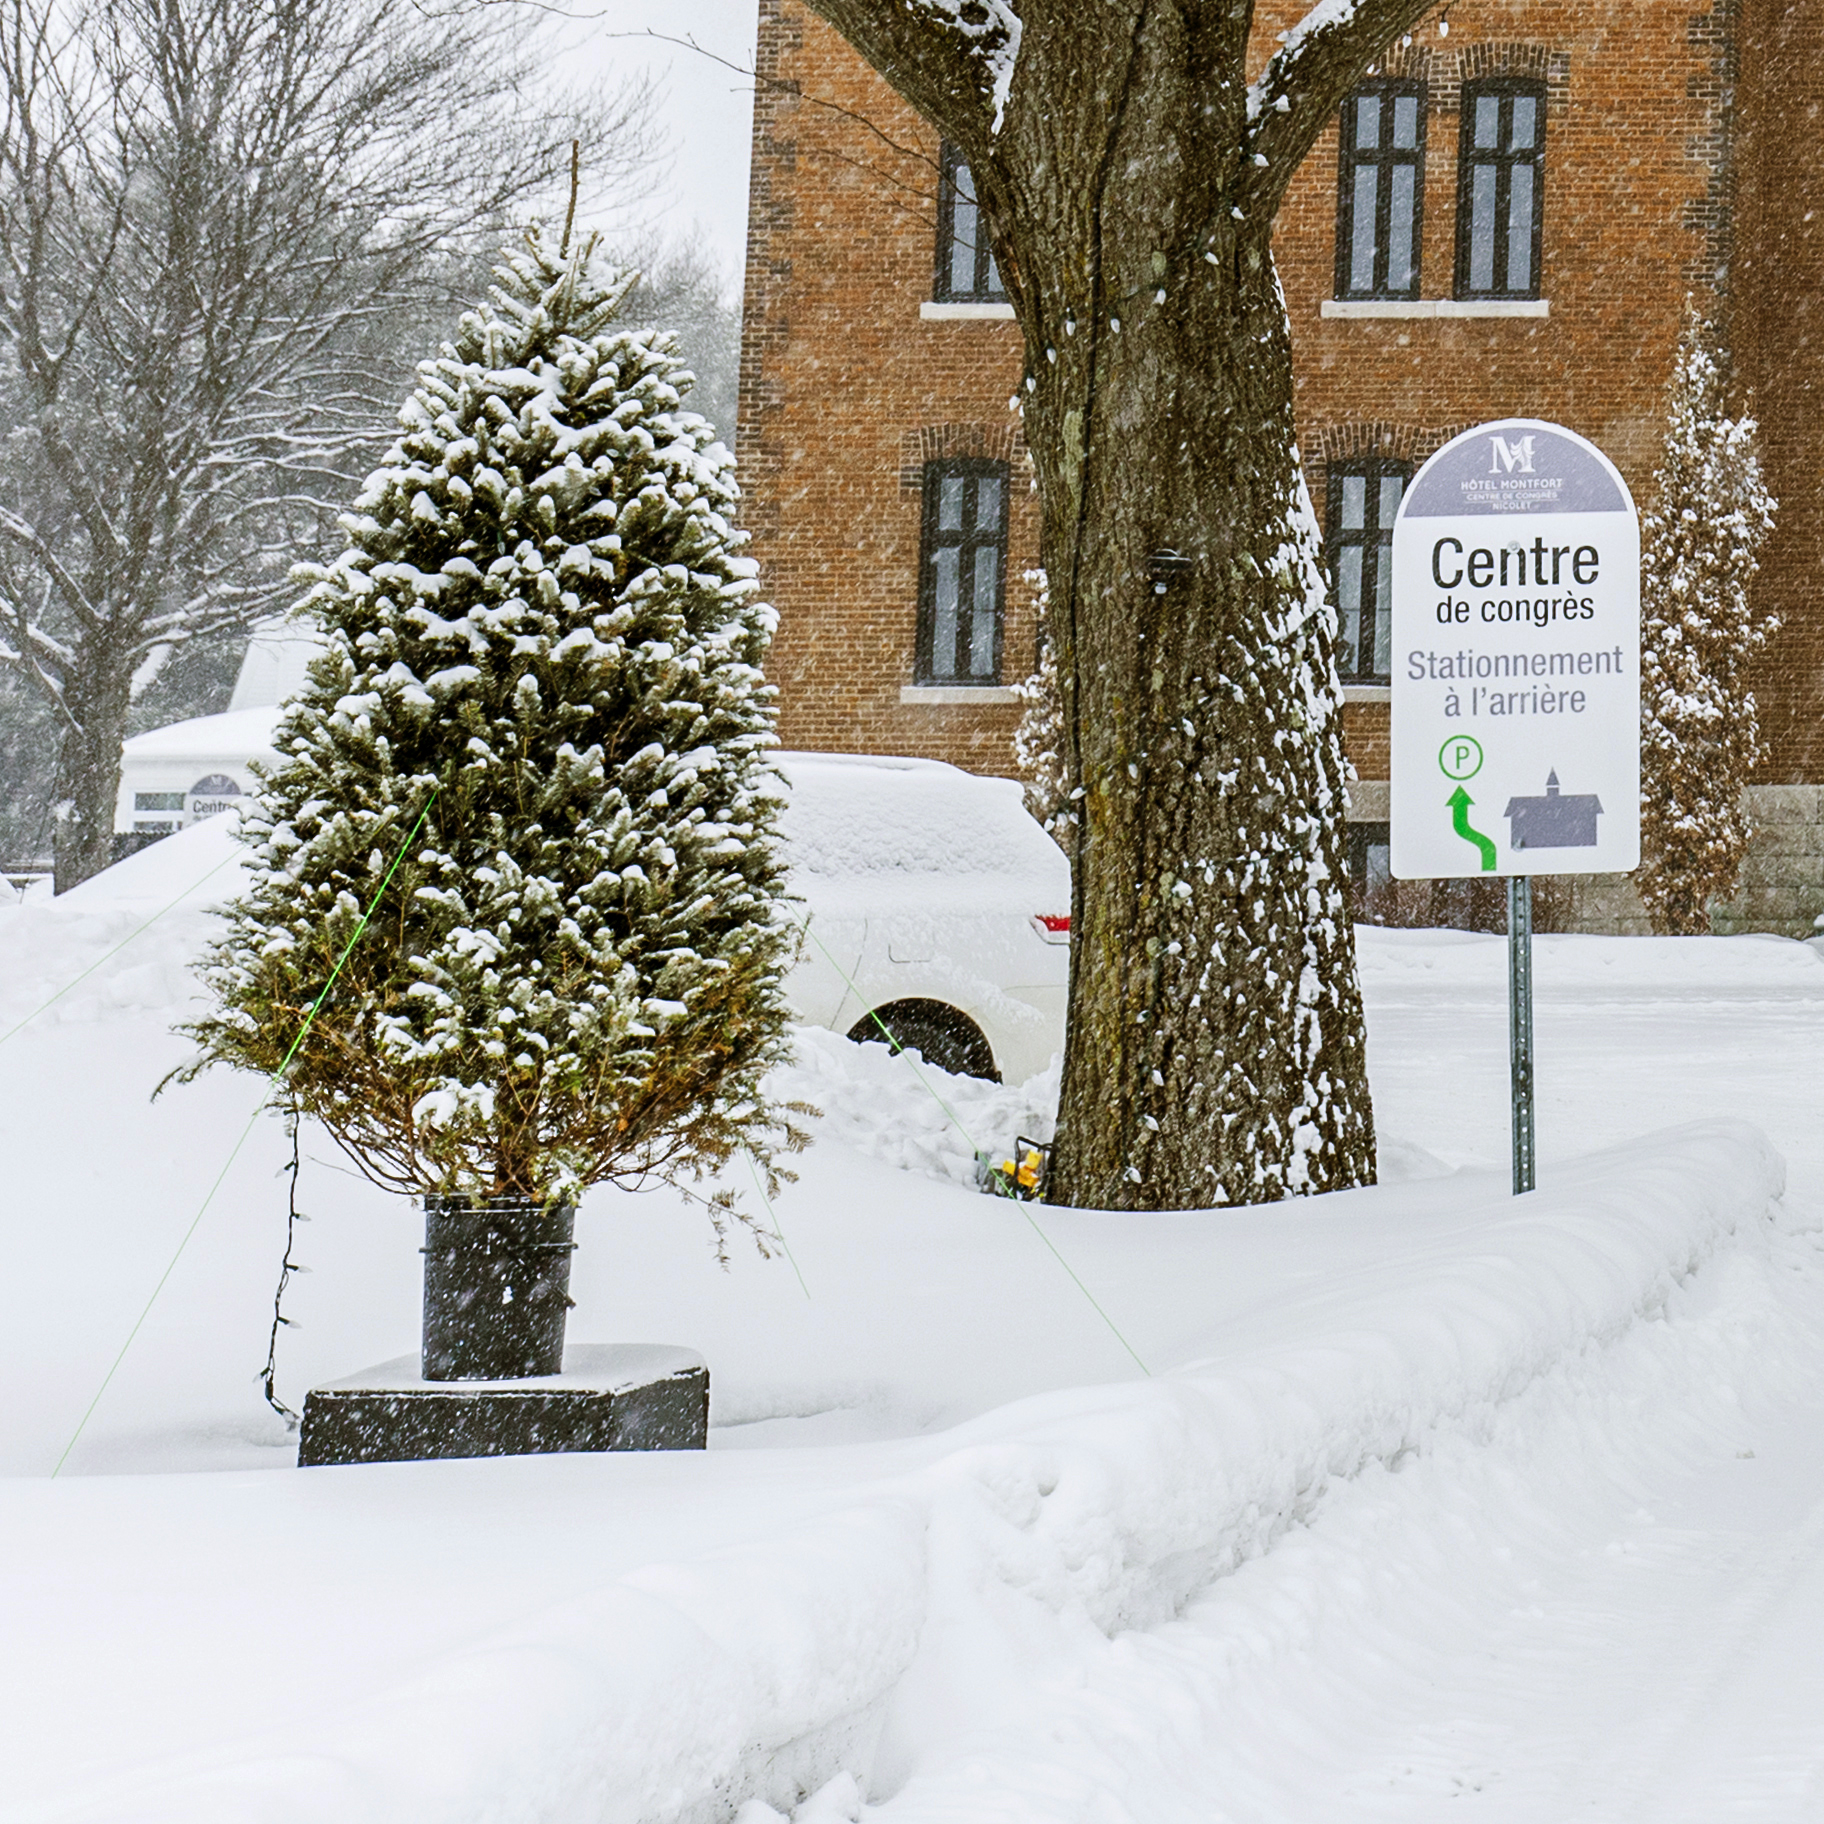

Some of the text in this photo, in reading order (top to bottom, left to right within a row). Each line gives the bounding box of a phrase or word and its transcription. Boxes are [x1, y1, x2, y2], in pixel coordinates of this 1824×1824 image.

[1460, 478, 1563, 491] HÔTEL MONTFORT
[1466, 490, 1558, 501] CENTRE DE CONGRÈS
[1492, 501, 1532, 510] NICOLET
[1432, 537, 1599, 589] Centre
[1436, 590, 1595, 627] de congrès
[1407, 645, 1624, 680] Stationnement
[1444, 683, 1586, 717] à l'arrière
[1456, 745, 1470, 770] P
[193, 799, 229, 813] Centr
